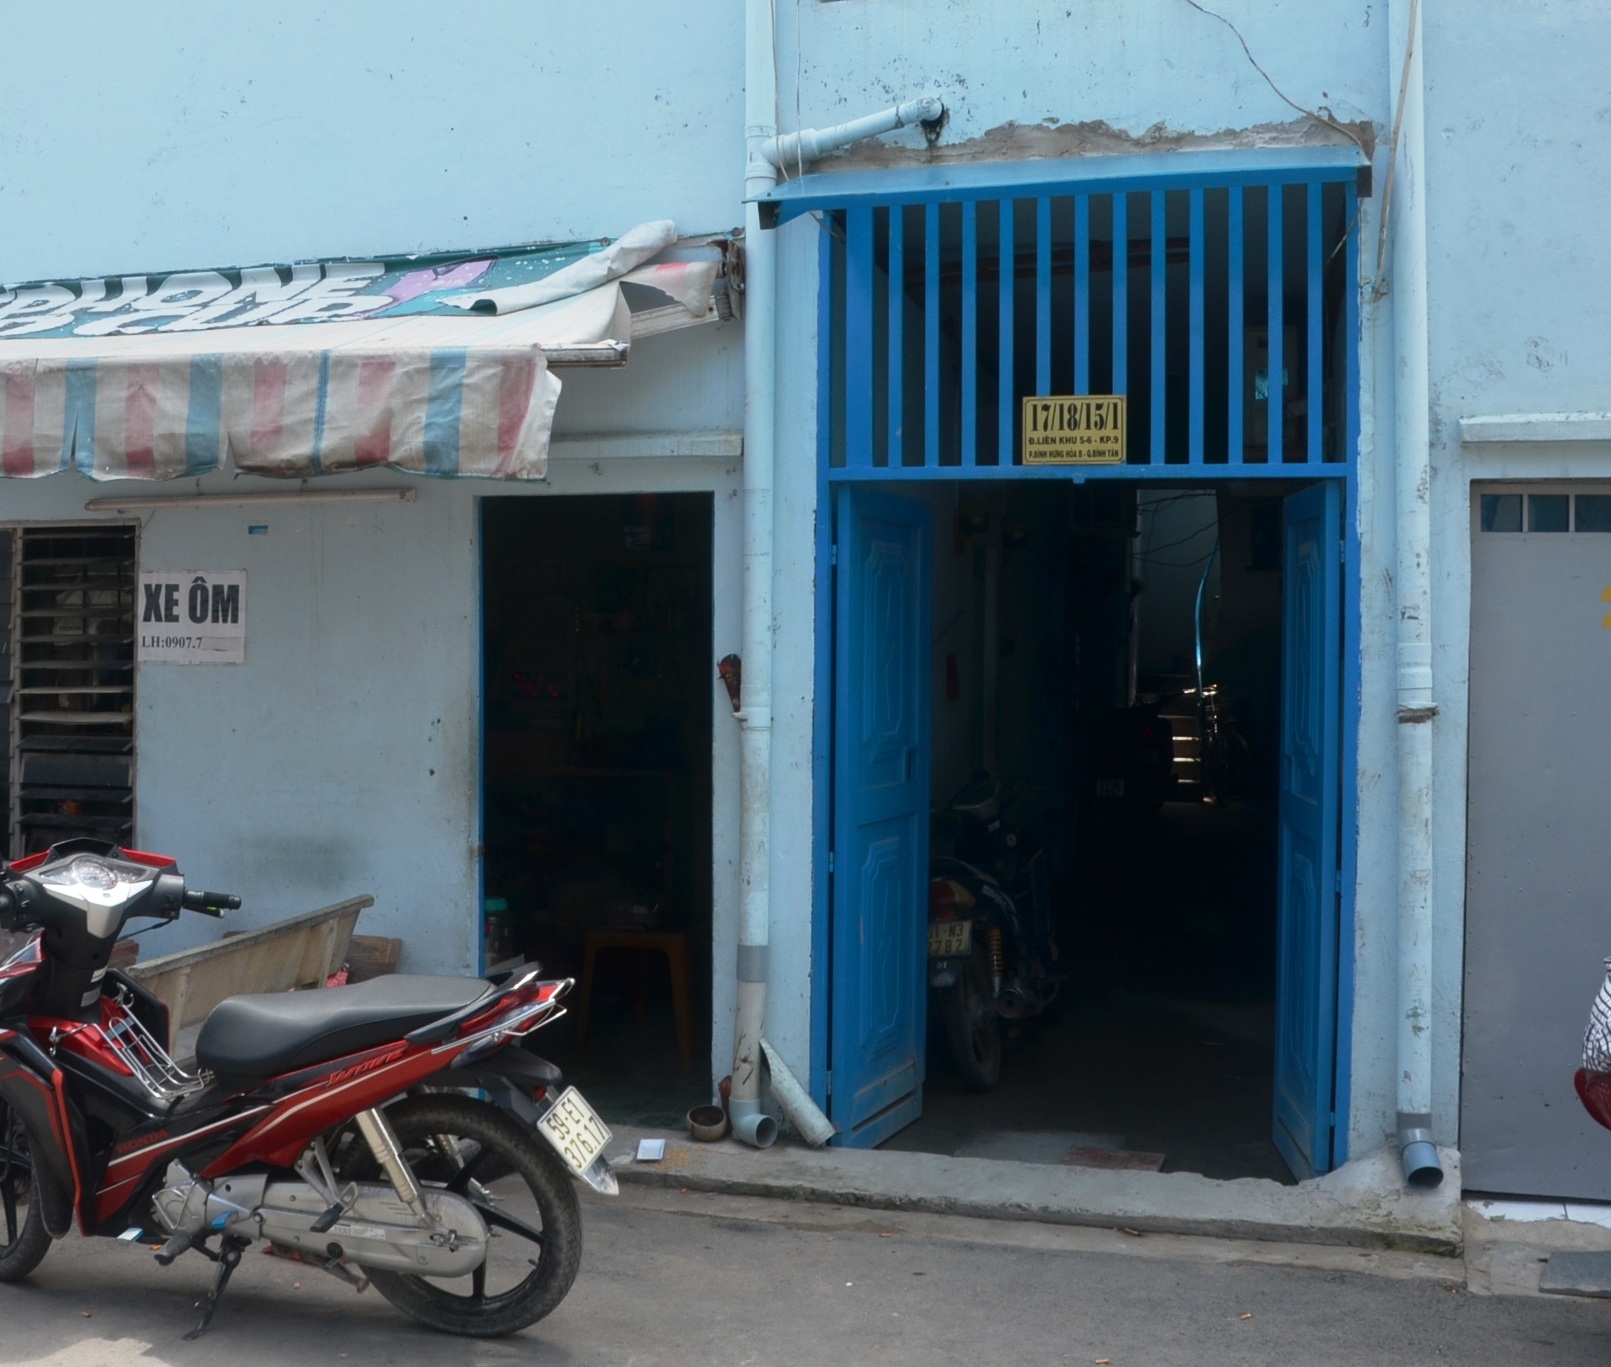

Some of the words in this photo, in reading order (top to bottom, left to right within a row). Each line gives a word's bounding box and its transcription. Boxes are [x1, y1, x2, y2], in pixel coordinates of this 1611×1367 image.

[1031, 402, 1119, 432] 17/18/15/1
[1059, 436, 1077, 445] KHU
[1079, 435, 1092, 444] 5-6
[1099, 435, 1119, 444] KP.9
[142, 584, 180, 622] XE
[188, 576, 240, 624] ÔM
[564, 1115, 606, 1168] 376.17
